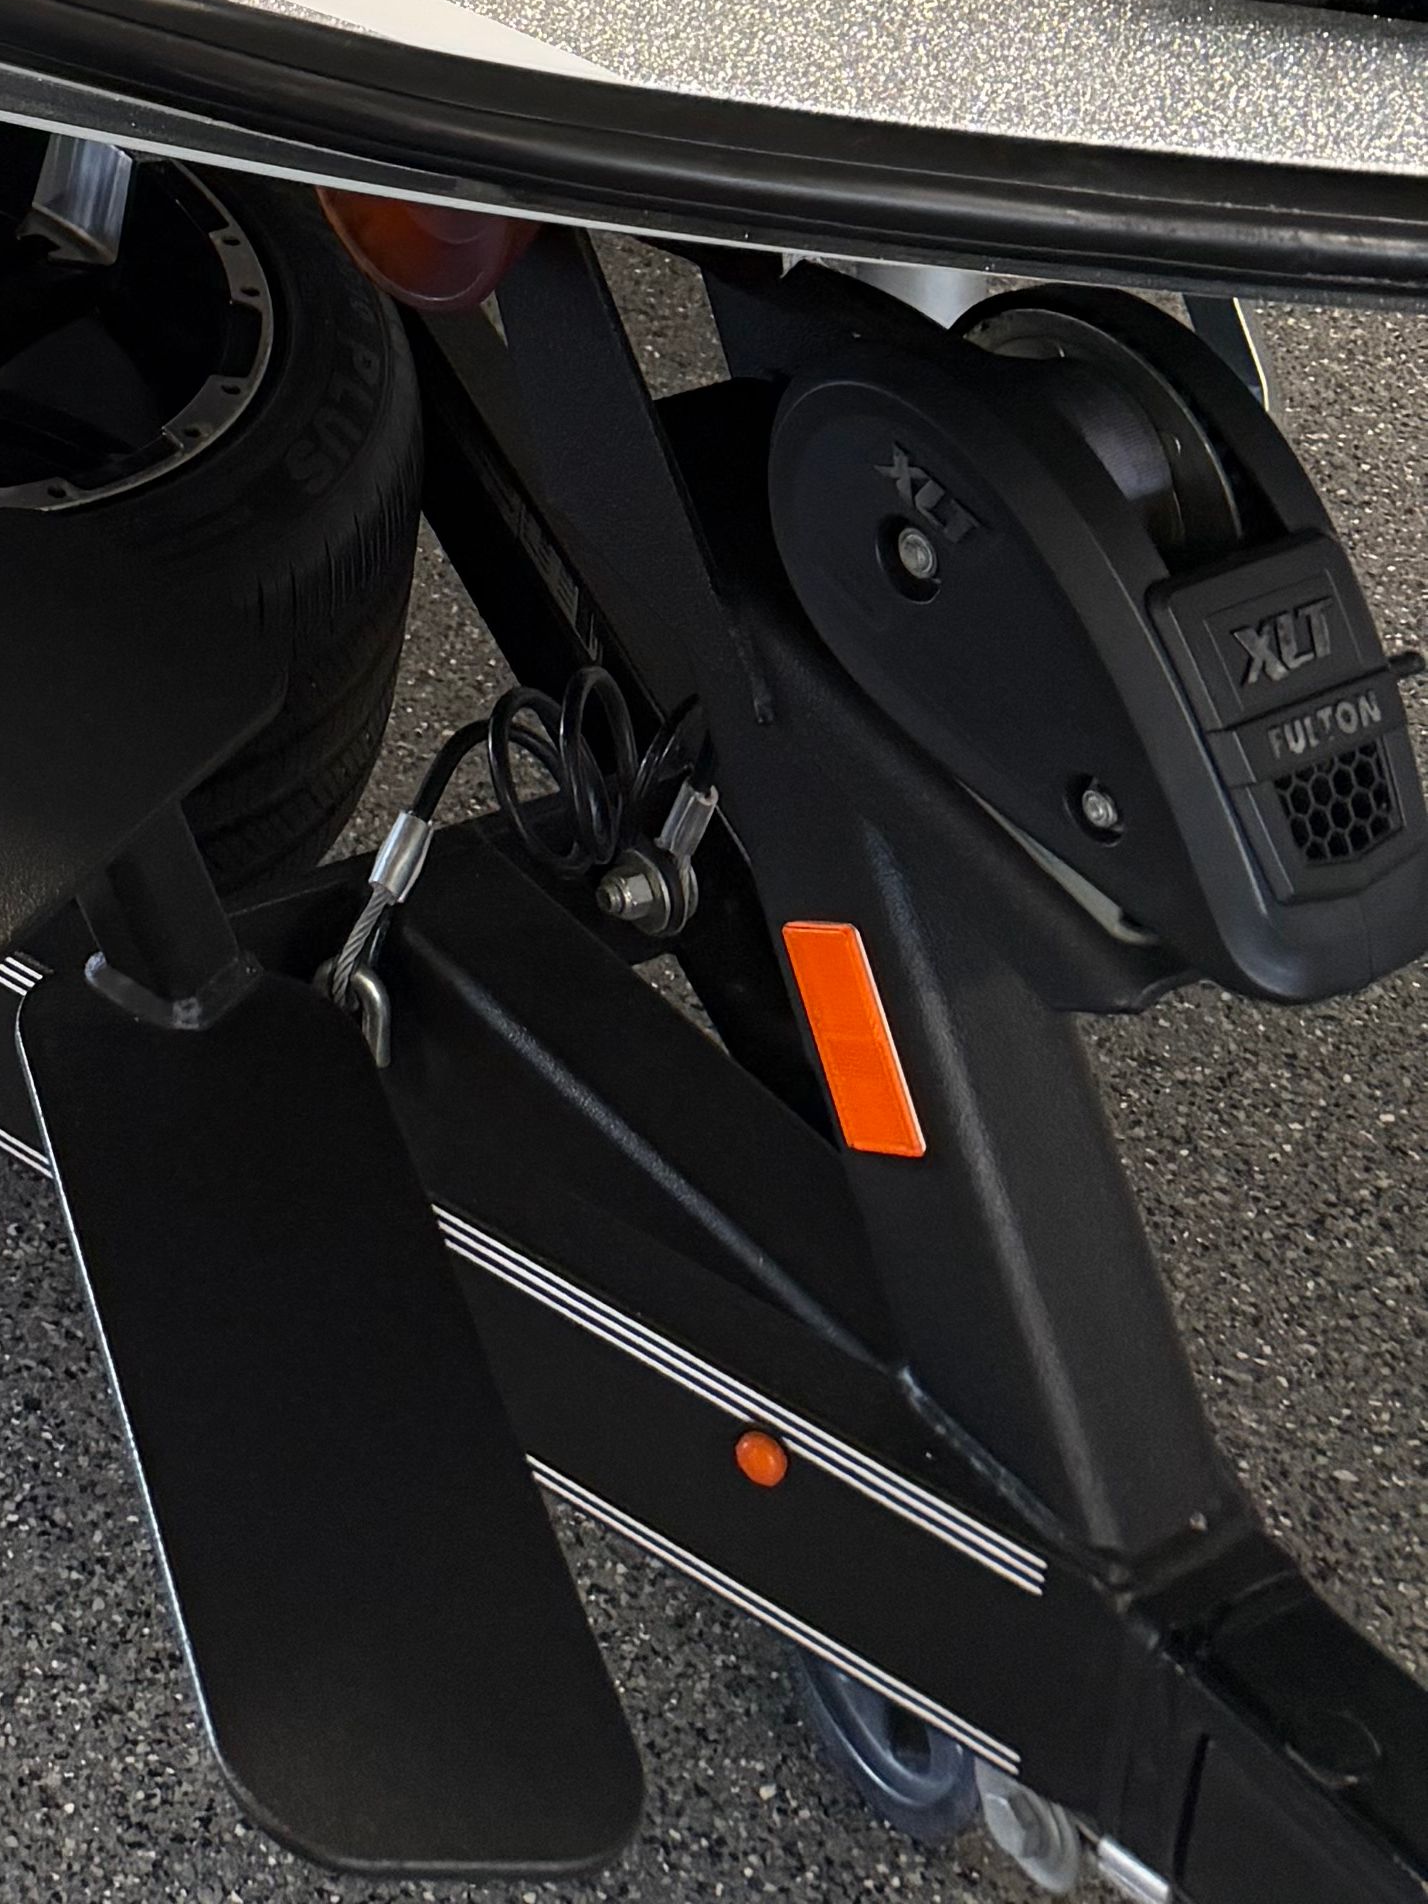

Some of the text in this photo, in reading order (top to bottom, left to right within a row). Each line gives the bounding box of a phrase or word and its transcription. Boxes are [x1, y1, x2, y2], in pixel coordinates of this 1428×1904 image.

[872, 440, 982, 544] XLT
[1230, 595, 1334, 687] XLT
[1268, 691, 1382, 760] FULTON
